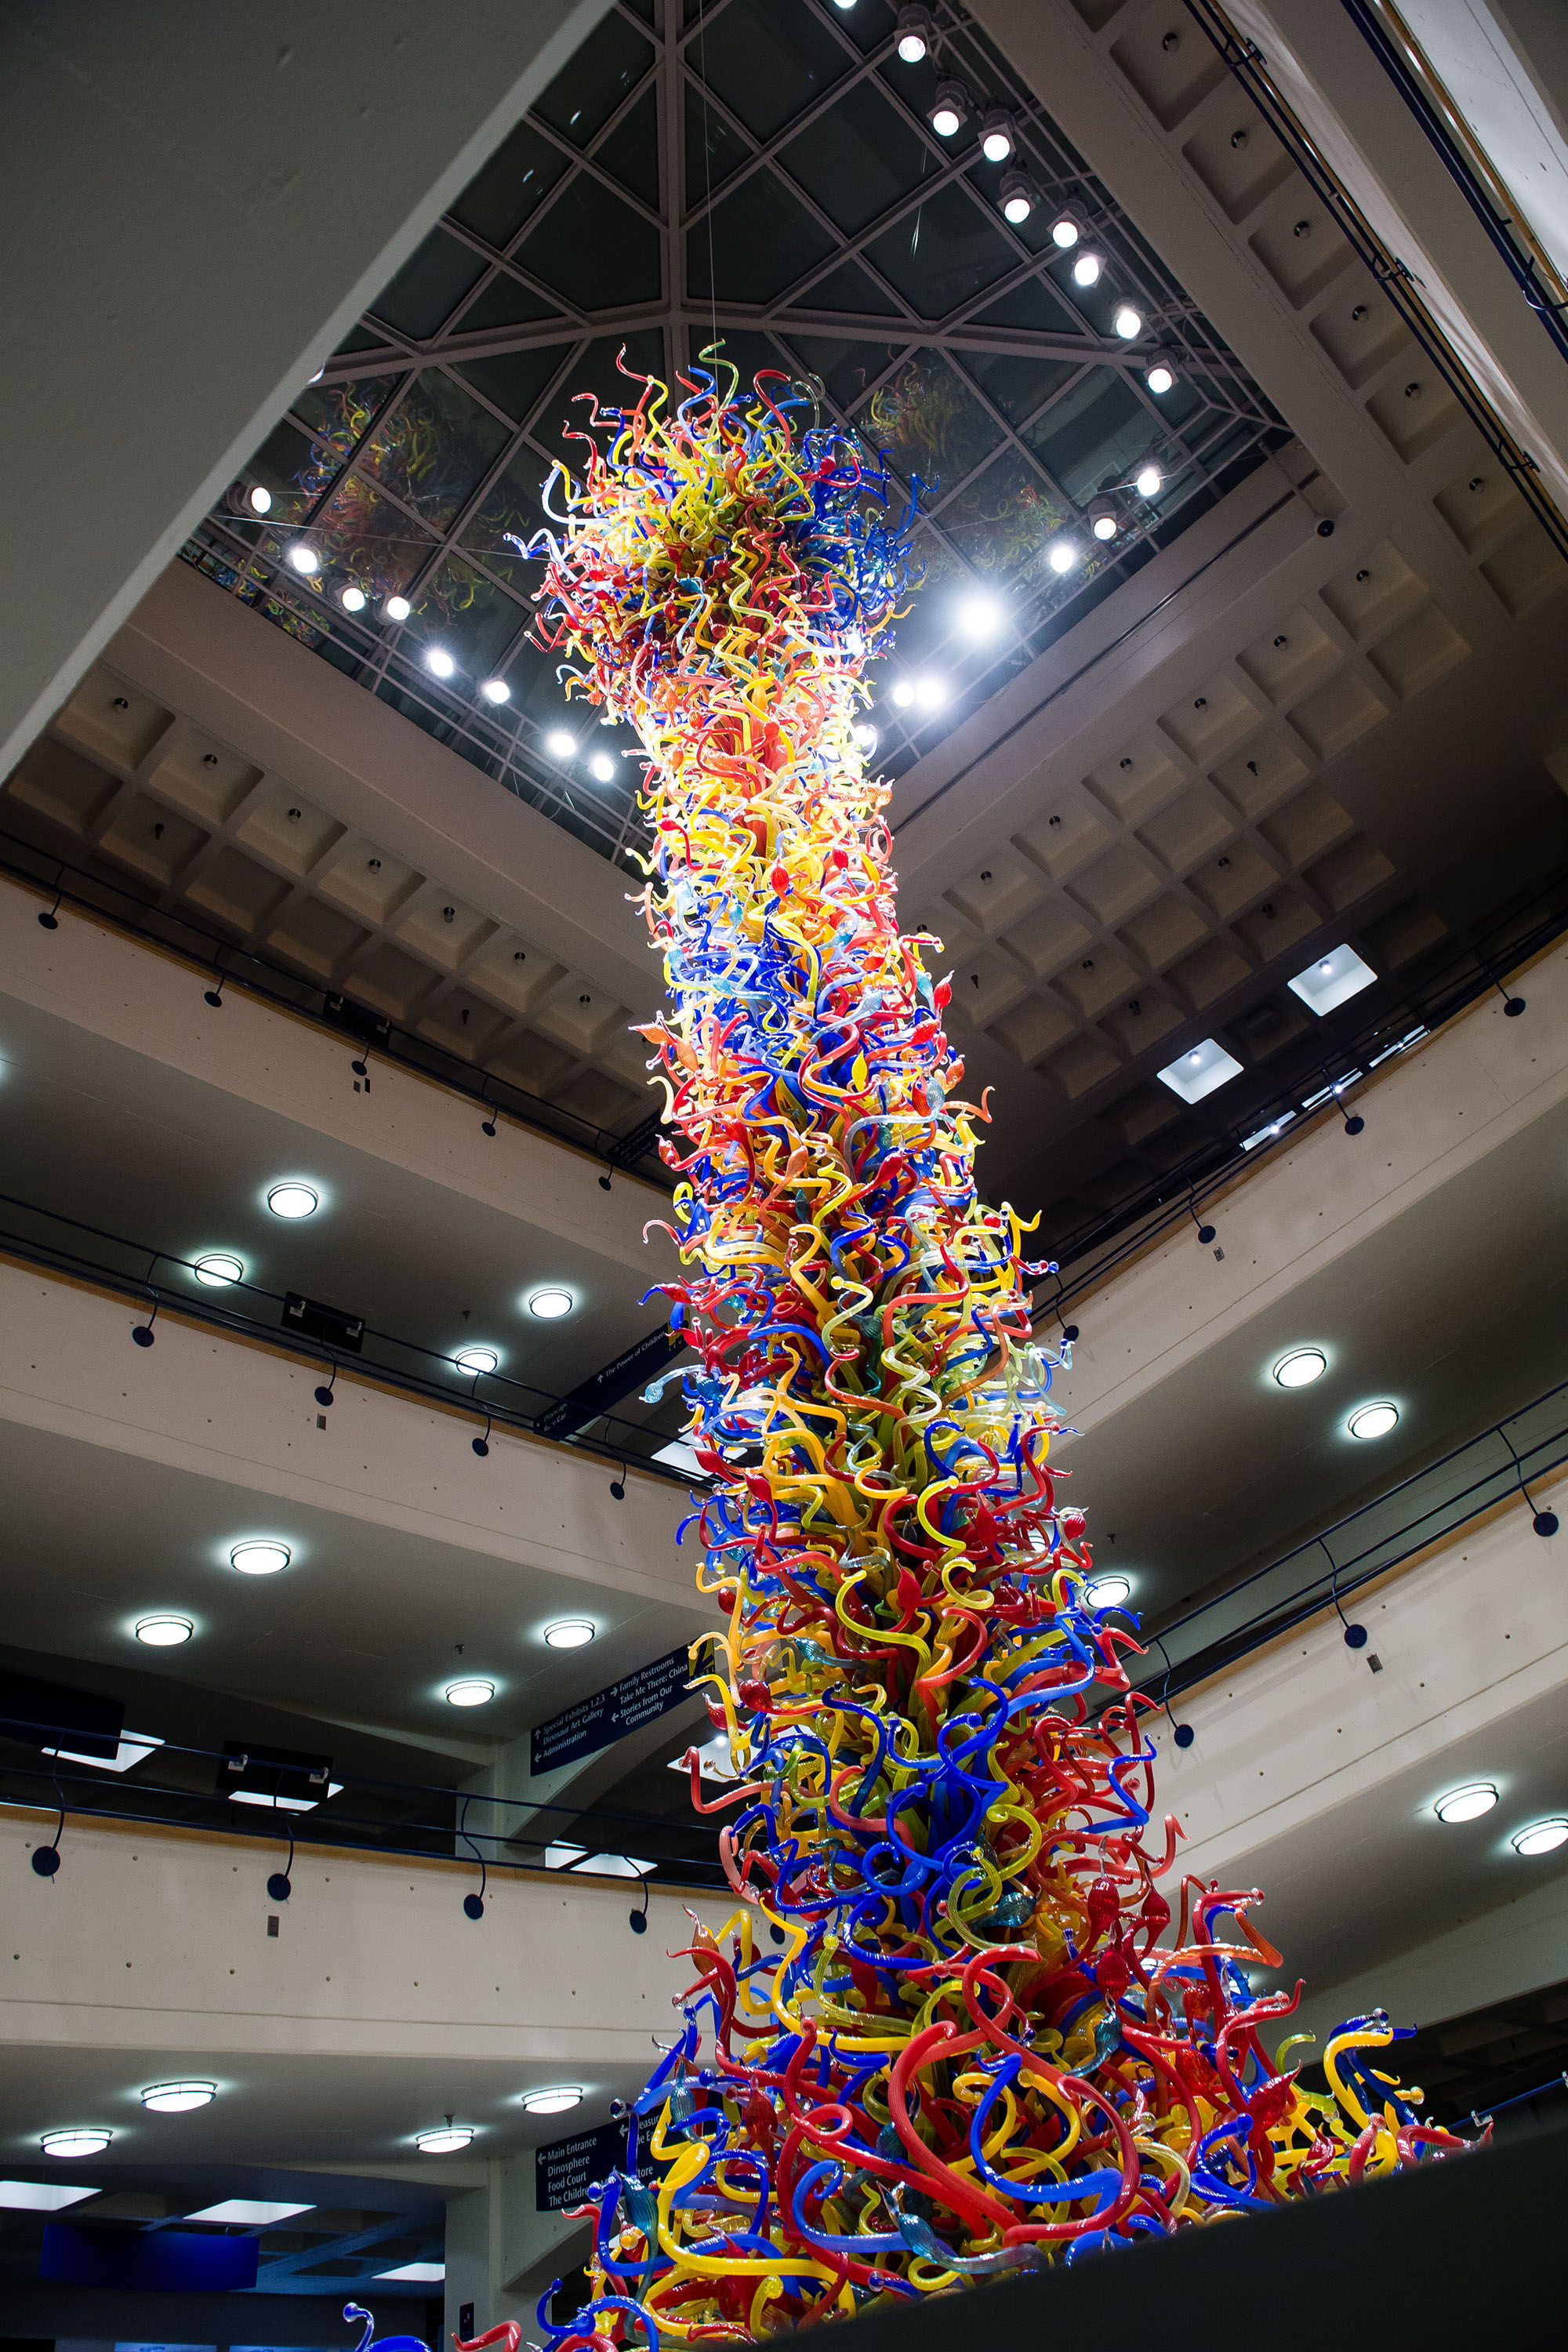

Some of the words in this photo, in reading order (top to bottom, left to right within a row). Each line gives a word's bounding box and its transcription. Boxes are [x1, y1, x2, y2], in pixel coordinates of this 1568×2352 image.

[605, 1367, 616, 1377] The
[616, 1354, 634, 1370] Power
[634, 1347, 641, 1357] of
[641, 1330, 666, 1351] Children
[619, 1675, 640, 1693] Family
[641, 1657, 675, 1681] Restrooms
[620, 1693, 634, 1704] Take
[635, 1686, 646, 1697] Me
[647, 1675, 668, 1691] There:
[669, 1664, 688, 1679] China
[543, 1715, 564, 1735] Special
[565, 1704, 589, 1722] Exhibits
[590, 1693, 605, 1708] 1,2,3
[620, 1701, 642, 1719] Stories
[642, 1693, 659, 1708] from
[659, 1684, 673, 1697] Our
[626, 1700, 664, 1726] Community
[543, 1726, 570, 1746] Dinosaur
[571, 1719, 581, 1731] Art
[582, 1708, 604, 1724] Gallery
[543, 1730, 587, 1759] Administration
[547, 2147, 565, 2161] Main
[566, 2137, 597, 2155] Entrance
[547, 2156, 590, 2178] Dinosphere
[637, 2165, 654, 2179] tore
[548, 2176, 565, 2194] Food
[566, 2170, 587, 2187] Court
[548, 2194, 562, 2208] The
[563, 2186, 590, 2202] Childre
